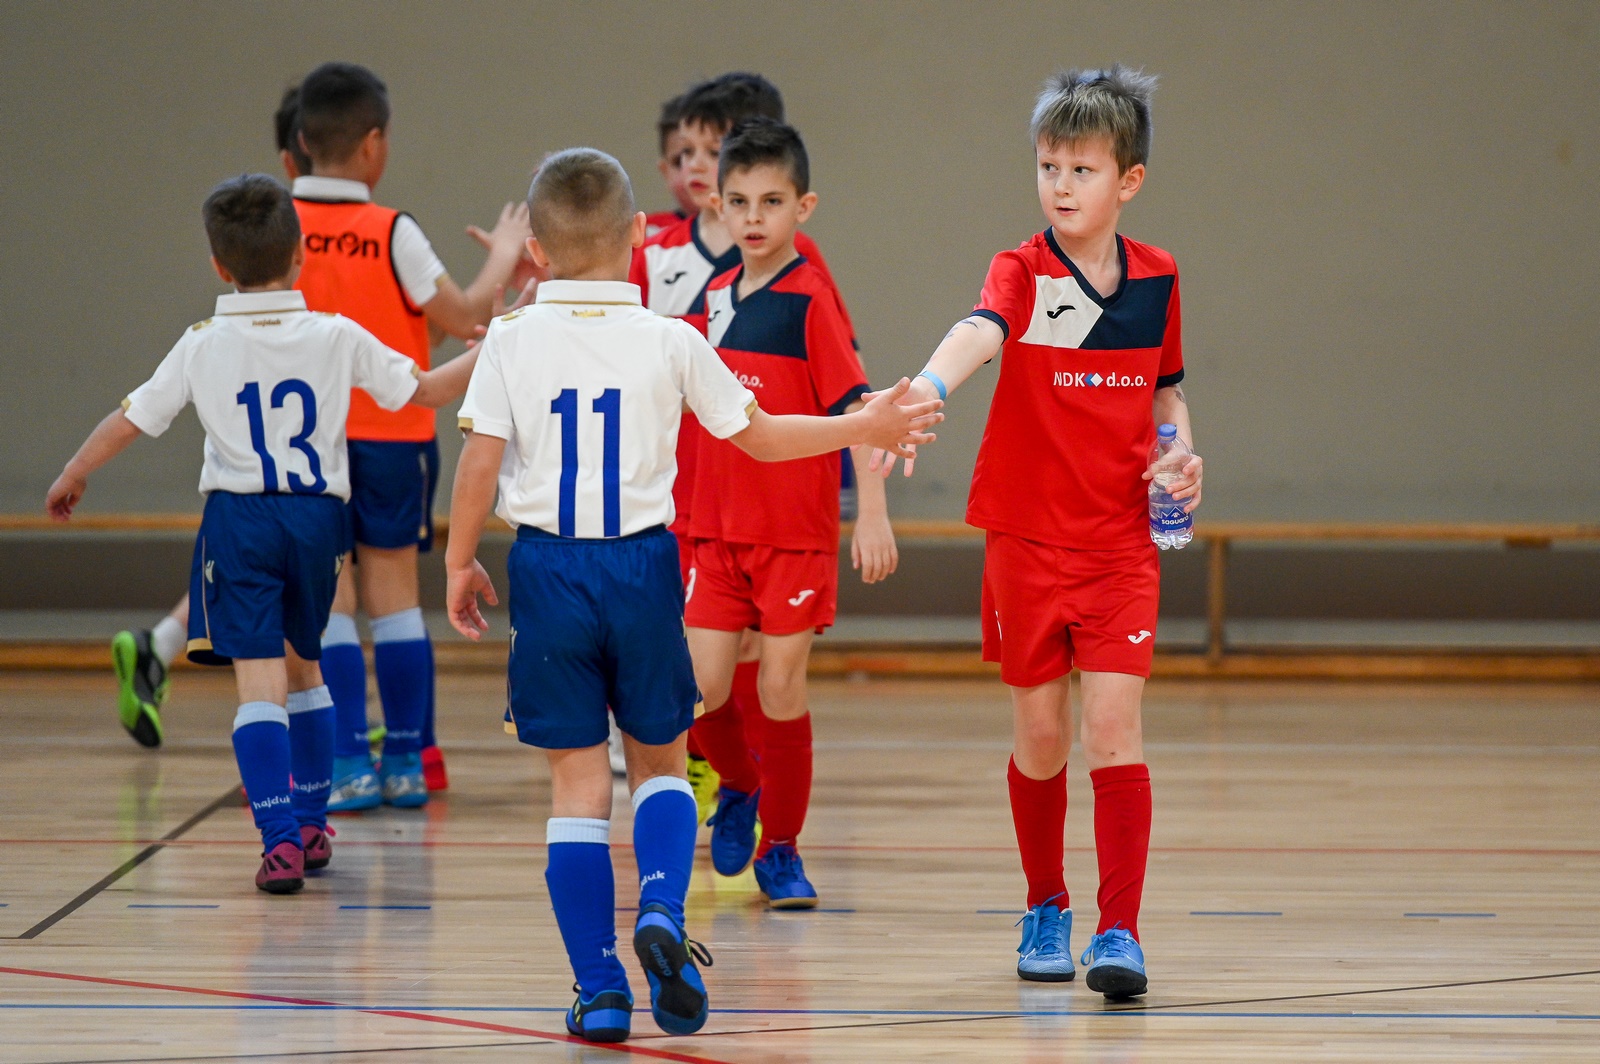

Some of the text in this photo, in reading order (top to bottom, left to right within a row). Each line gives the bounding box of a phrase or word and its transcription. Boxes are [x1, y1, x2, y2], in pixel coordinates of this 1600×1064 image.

[236, 378, 328, 494] 13
[1053, 371, 1148, 387] NDK d.o.o.
[550, 388, 621, 538] 11
